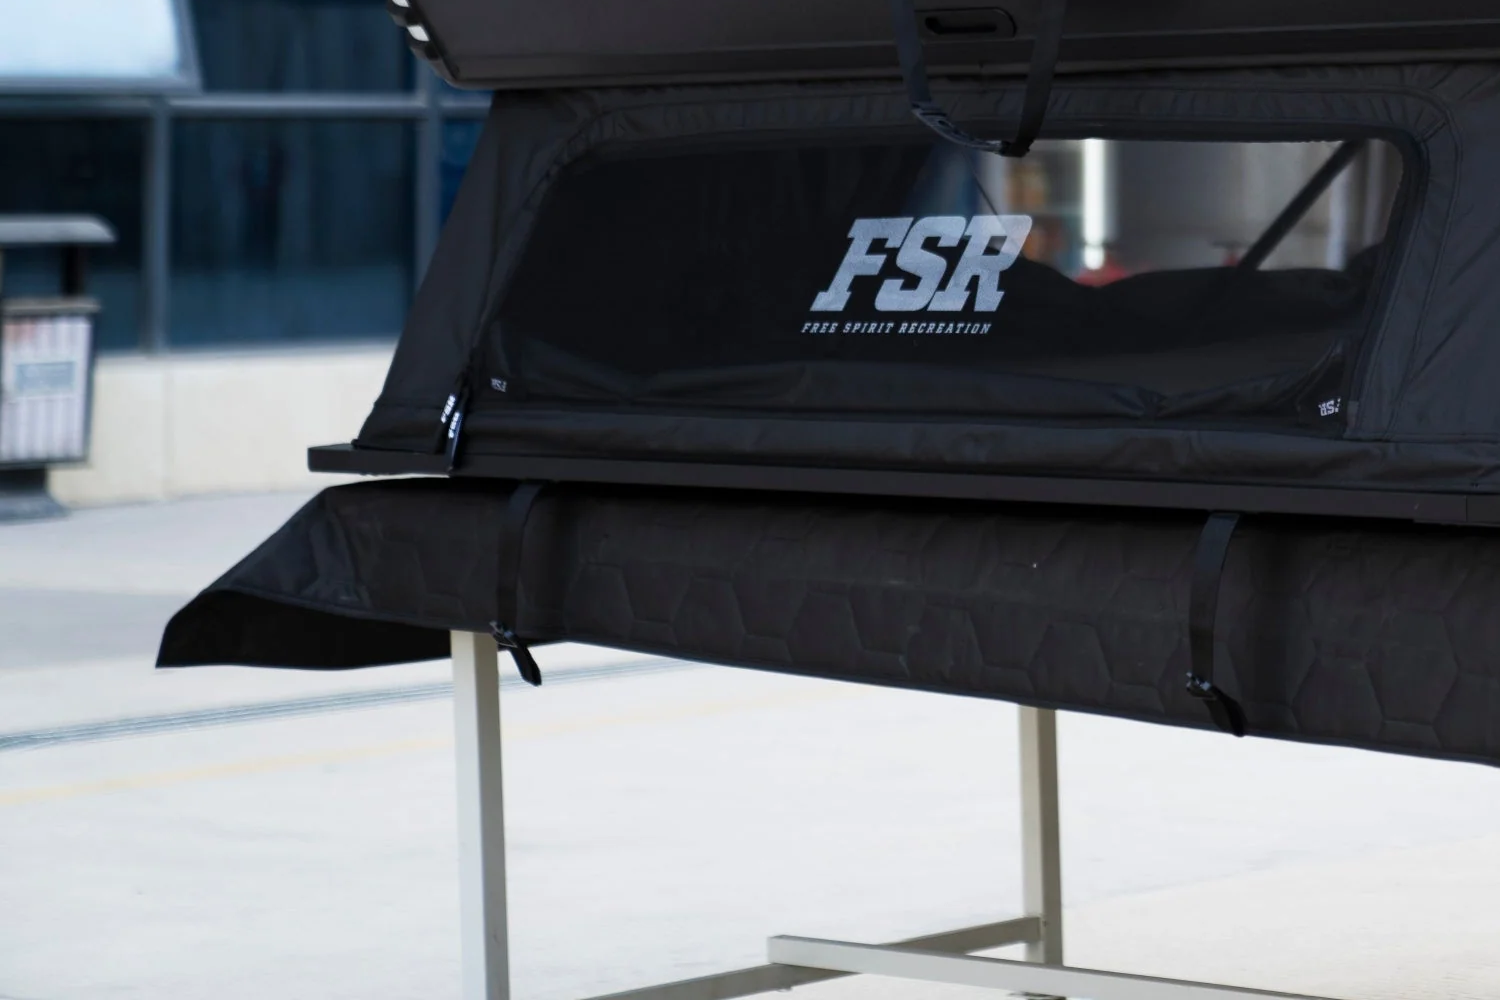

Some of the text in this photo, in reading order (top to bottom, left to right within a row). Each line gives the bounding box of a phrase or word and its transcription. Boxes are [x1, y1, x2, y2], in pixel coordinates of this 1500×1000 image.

[810, 214, 1032, 312] FSR
[801, 322, 992, 334] FREE SPIRIT RECREATION
